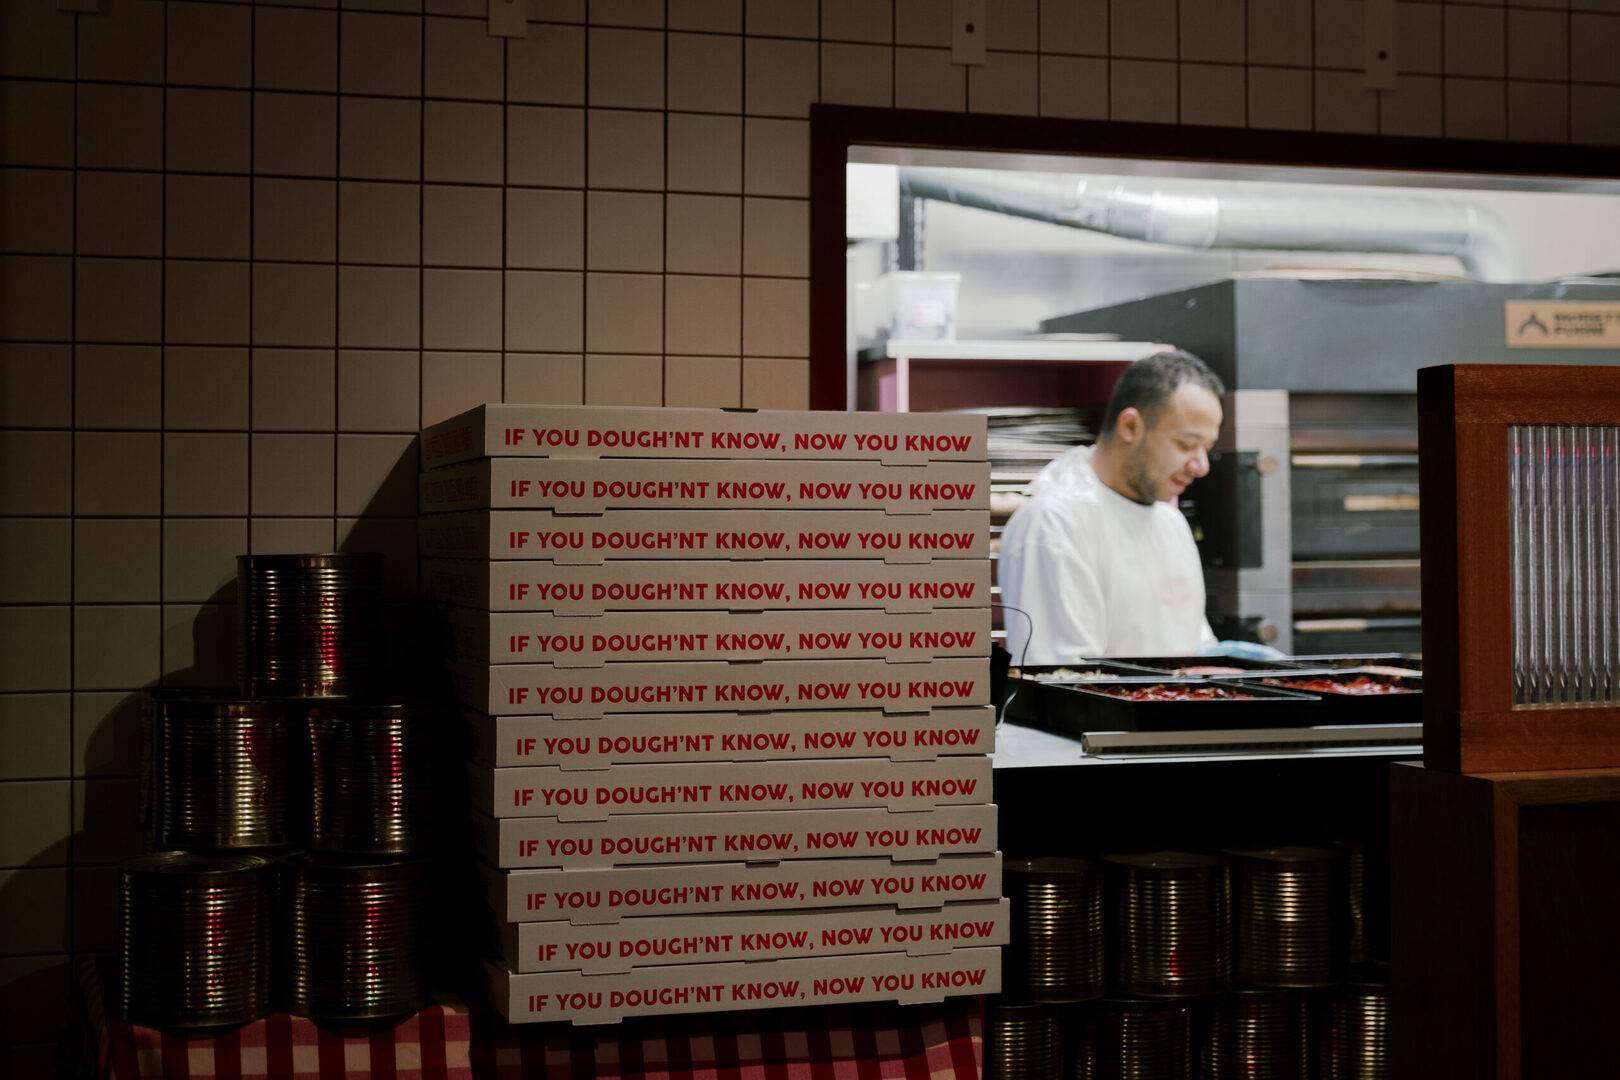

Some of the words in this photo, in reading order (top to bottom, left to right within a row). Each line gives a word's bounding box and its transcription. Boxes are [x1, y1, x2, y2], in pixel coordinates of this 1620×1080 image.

[504, 427, 526, 447] IF
[532, 428, 580, 447] YOU
[586, 429, 705, 449] DOUGH'NT
[711, 431, 787, 453] KNOW,
[794, 432, 847, 451] NOW
[853, 433, 899, 452] YOU
[904, 434, 972, 453] KNOW
[510, 479, 532, 497] IF
[538, 479, 586, 498] YOU
[591, 480, 710, 499] DOUGH'NT
[716, 481, 792, 503] KNOW,
[799, 482, 853, 501] NOW
[858, 482, 903, 501] YOU
[909, 482, 976, 501] KNOW
[509, 531, 530, 549] IF
[536, 530, 585, 550] YOU
[591, 530, 709, 550] DOUGH'NT
[715, 531, 791, 552] KNOW,
[798, 532, 852, 550] NOW
[857, 531, 902, 550] YOU
[908, 532, 975, 550] KNOW
[509, 582, 529, 601] IF
[537, 582, 585, 601] YOU
[591, 582, 709, 602] DOUGH'NT
[714, 582, 791, 603] KNOW,
[798, 582, 852, 601] NOW
[857, 581, 902, 601] YOU
[908, 582, 976, 600] KNOW
[509, 635, 531, 654] IF
[537, 634, 585, 653] YOU
[591, 633, 709, 653] DOUGH'NT
[715, 632, 791, 653] KNOW,
[798, 632, 852, 651] NOW
[857, 631, 904, 650] YOU
[909, 631, 976, 649] KNOW
[508, 687, 529, 705] IF
[535, 686, 584, 705] YOU
[590, 684, 709, 705] DOUGH'NT
[714, 683, 791, 704] KNOW,
[797, 682, 851, 701] NOW
[856, 681, 902, 701] YOU
[907, 680, 975, 699] KNOW
[516, 737, 537, 756] IF
[544, 736, 591, 756] YOU
[597, 734, 715, 754] DOUGH'NT
[721, 732, 797, 753] KNOW,
[803, 731, 857, 750] NOW
[863, 730, 907, 748] YOU
[913, 728, 981, 748] KNOW
[513, 787, 535, 807] IF
[542, 787, 589, 806] YOU
[595, 784, 713, 805] DOUGH'NT
[719, 783, 794, 803] KNOW,
[801, 782, 854, 801] NOW
[860, 780, 905, 798] YOU
[911, 778, 977, 797] KNOW
[518, 839, 540, 858] IF
[546, 838, 594, 857] YOU
[599, 834, 718, 856] DOUGH'NT
[723, 832, 799, 852] KNOW,
[806, 831, 859, 849] NOW
[865, 830, 910, 848] YOU
[915, 827, 982, 847] KNOW
[527, 892, 546, 911] IF
[555, 890, 602, 910] YOU
[607, 884, 724, 908] DOUGH'NT
[730, 880, 805, 902] KNOW,
[812, 878, 865, 898] NOW
[870, 876, 915, 896] YOU
[920, 873, 987, 893] KNOW
[538, 943, 558, 961] IF
[565, 941, 612, 961] YOU
[618, 934, 734, 958] DOUGH'NT
[740, 930, 814, 952] KNOW,
[821, 927, 874, 947] NOW
[879, 924, 923, 944] YOU
[929, 921, 994, 941] KNOW
[528, 994, 549, 1011] IF
[555, 991, 603, 1011] YOU
[609, 984, 725, 1009] DOUGH'NT
[731, 980, 806, 1002] KNOW,
[812, 976, 865, 996] NOW
[871, 974, 915, 993] YOU
[921, 969, 986, 990] KNOW
